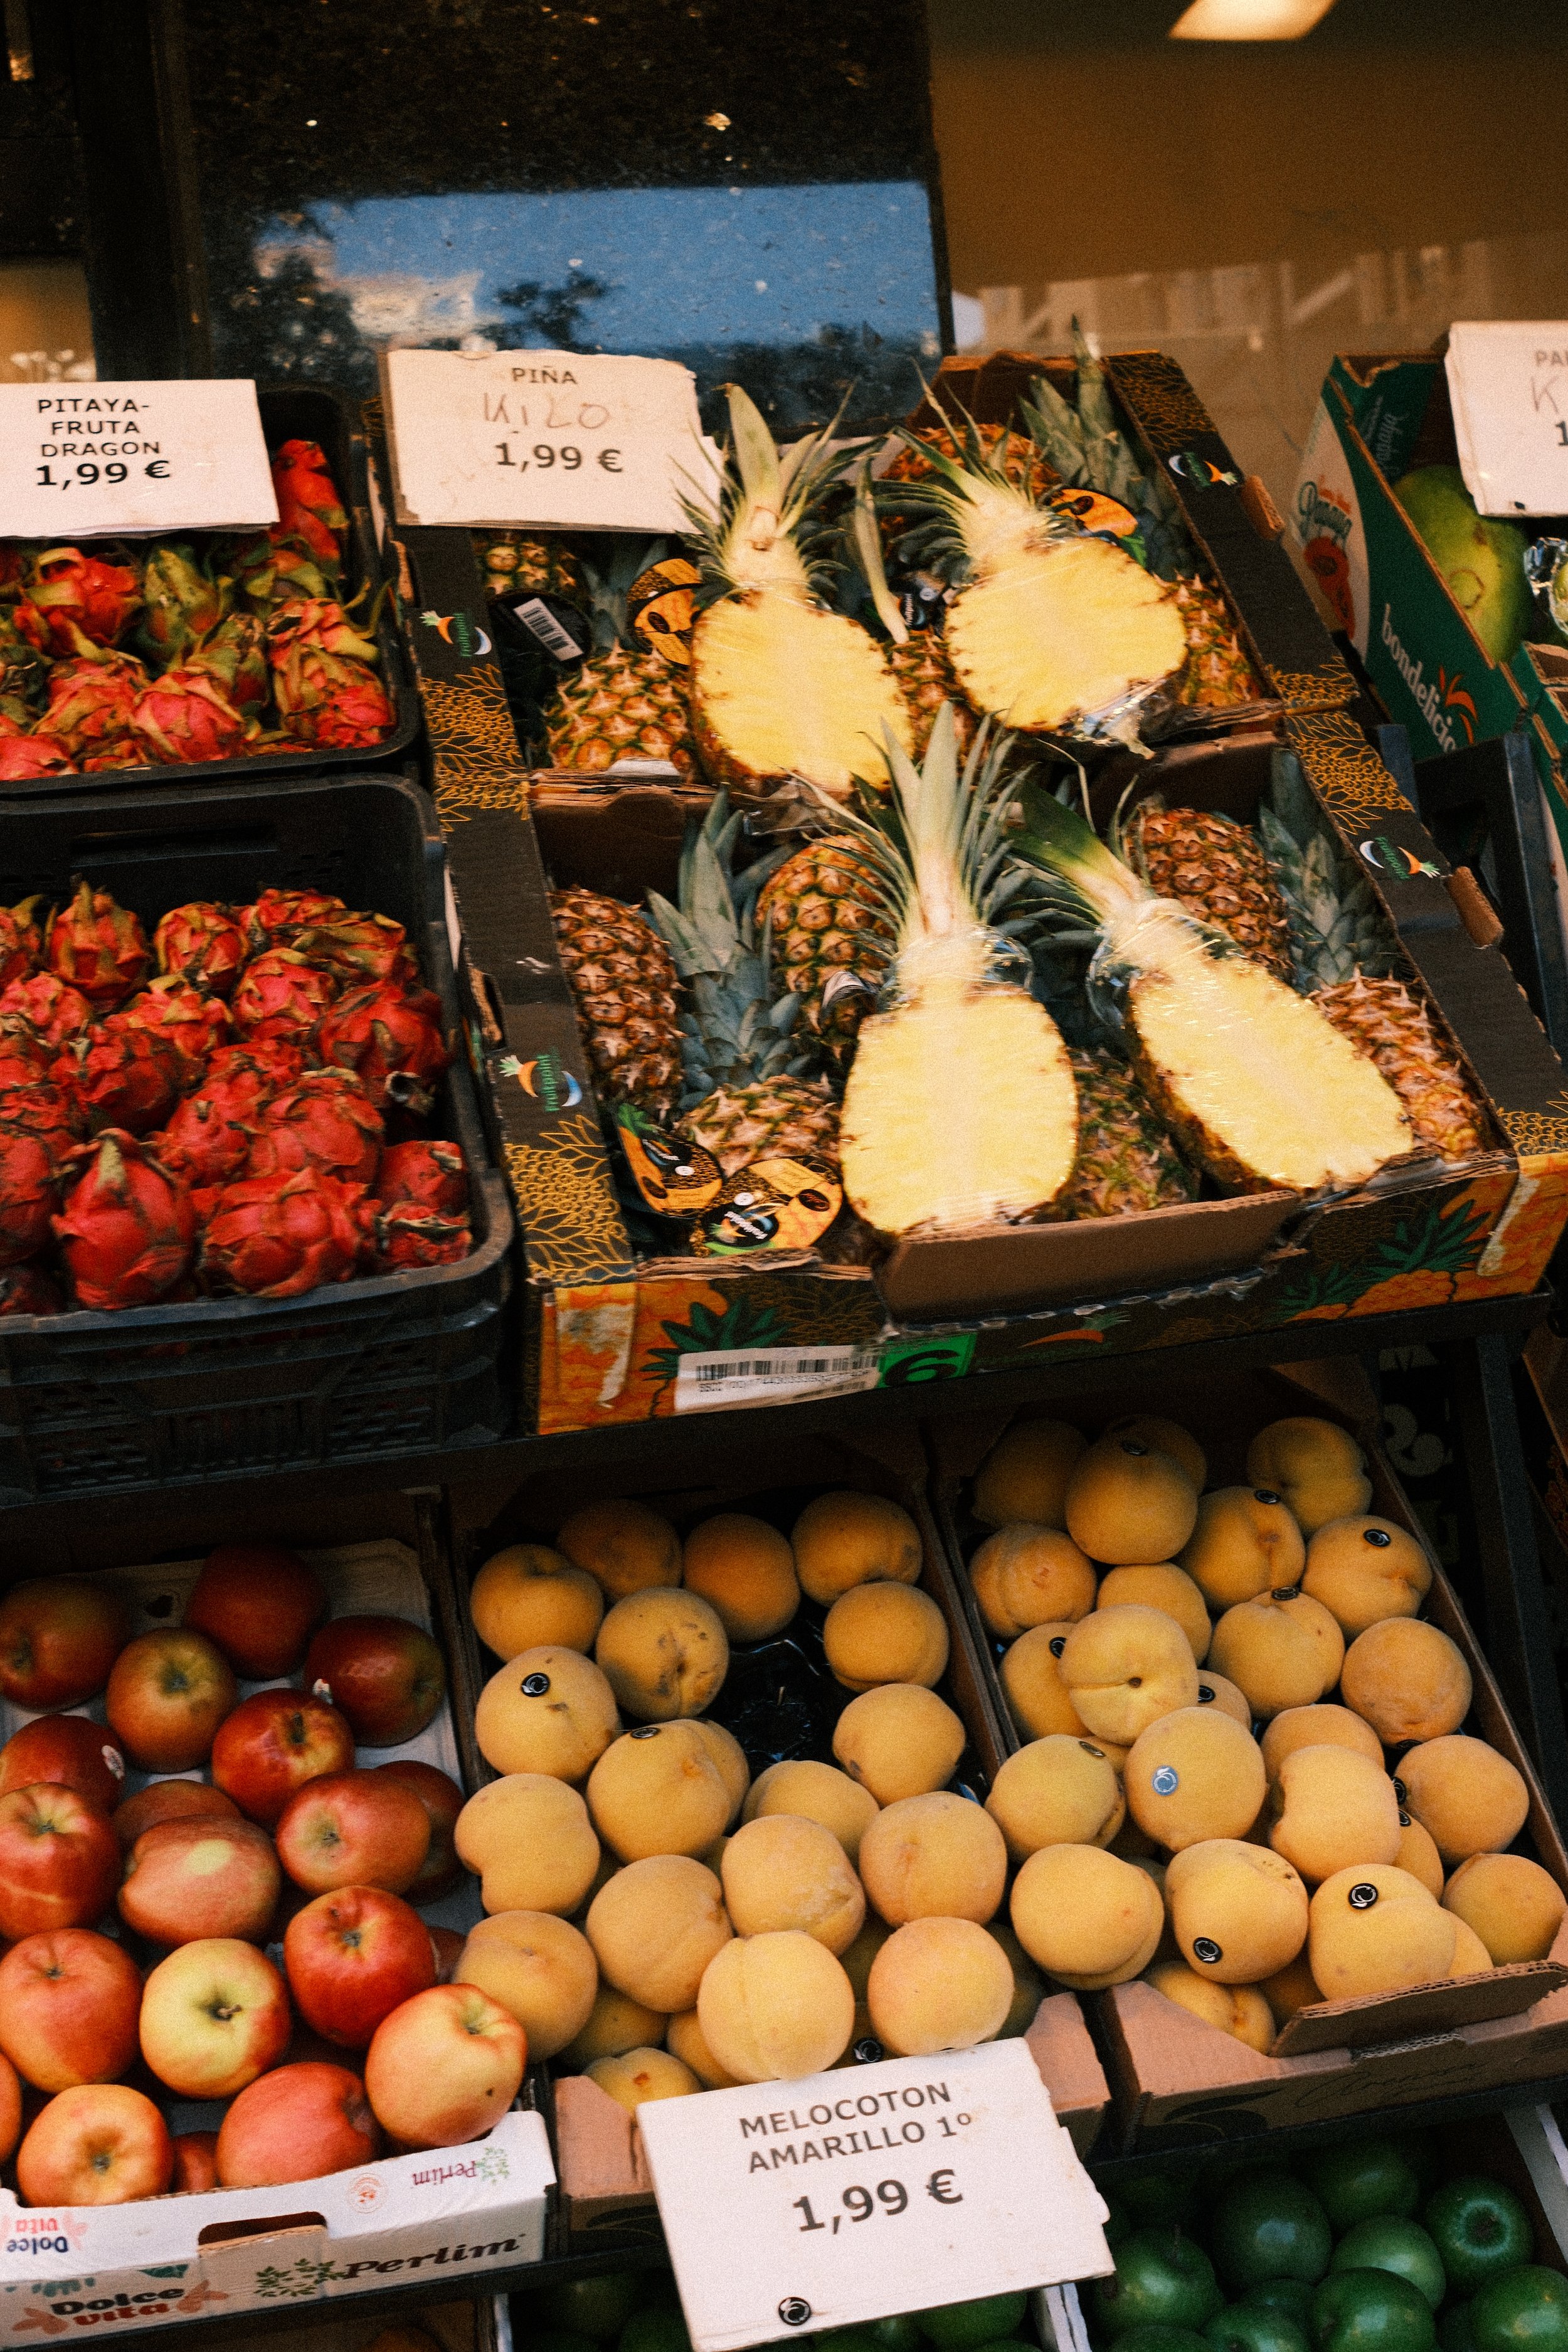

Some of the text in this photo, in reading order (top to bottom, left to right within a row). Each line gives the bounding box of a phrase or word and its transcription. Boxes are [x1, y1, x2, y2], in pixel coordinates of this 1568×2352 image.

[511, 366, 578, 385] PIÑA
[37, 397, 150, 414] PITAYA-
[51, 420, 141, 436] FRUTA
[41, 440, 161, 458] DRAGON
[495, 442, 623, 474] 1,99 €
[36, 460, 172, 490] 1,99 €
[739, 2081, 951, 2139] MELOCOTON
[748, 2121, 926, 2174] AMARILLO
[792, 2168, 963, 2235] 1,99 €
[6, 2235, 69, 2255] Dolce
[344, 2236, 519, 2280] Perlim
[51, 2286, 184, 2316] Dolce
[72, 2299, 170, 2327] vita
